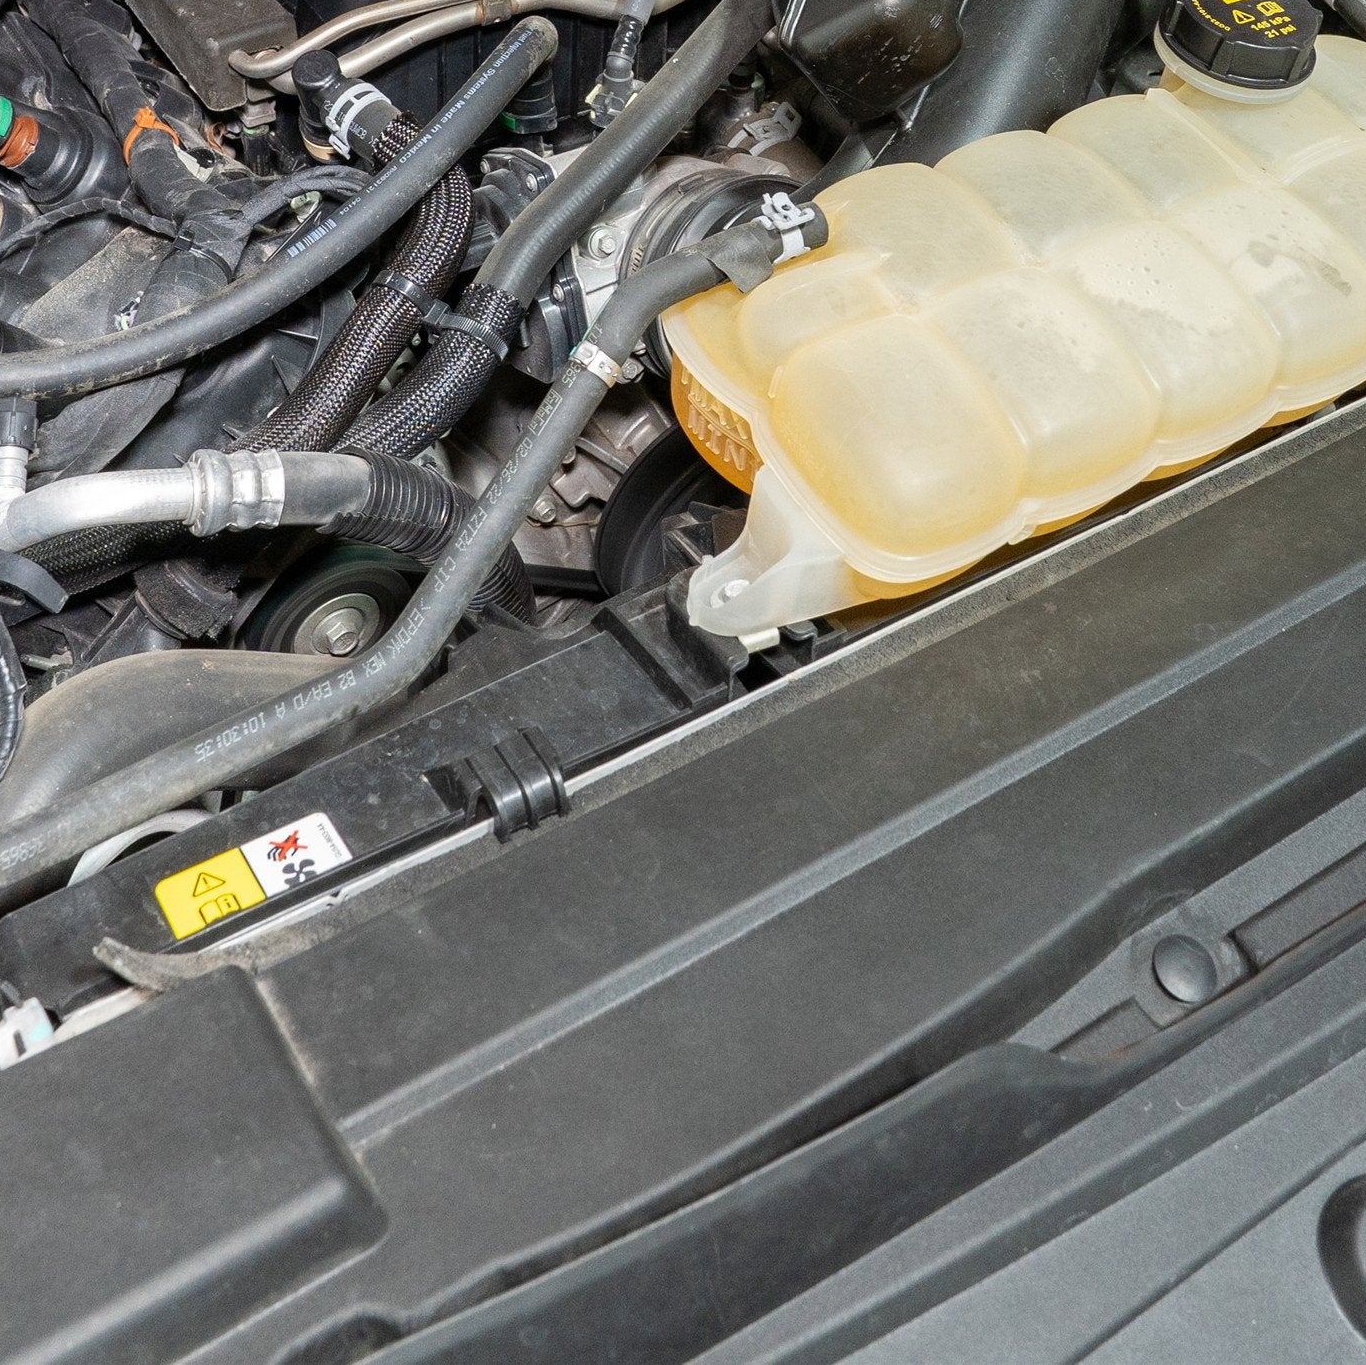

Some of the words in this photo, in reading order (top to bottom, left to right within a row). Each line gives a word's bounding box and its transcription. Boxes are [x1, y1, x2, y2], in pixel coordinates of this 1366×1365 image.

[517, 29, 532, 44] Fuel
[1251, 21, 1270, 31] 145
[1269, 15, 1292, 26] kPa
[1265, 30, 1279, 39] 21
[1280, 24, 1296, 35] psi
[491, 38, 521, 69] Injection
[461, 65, 496, 102] Systems
[439, 98, 465, 125] Made
[430, 123, 442, 135] in
[398, 131, 432, 167] Mexico
[692, 391, 753, 440] MAX
[685, 411, 749, 473] MIN
[482, 435, 537, 505] 02/26/22
[427, 555, 460, 594] CIP
[358, 651, 388, 678] MEX
[334, 668, 359, 692] B2
[272, 701, 291, 721] A
[191, 710, 270, 763] 10:30:35
